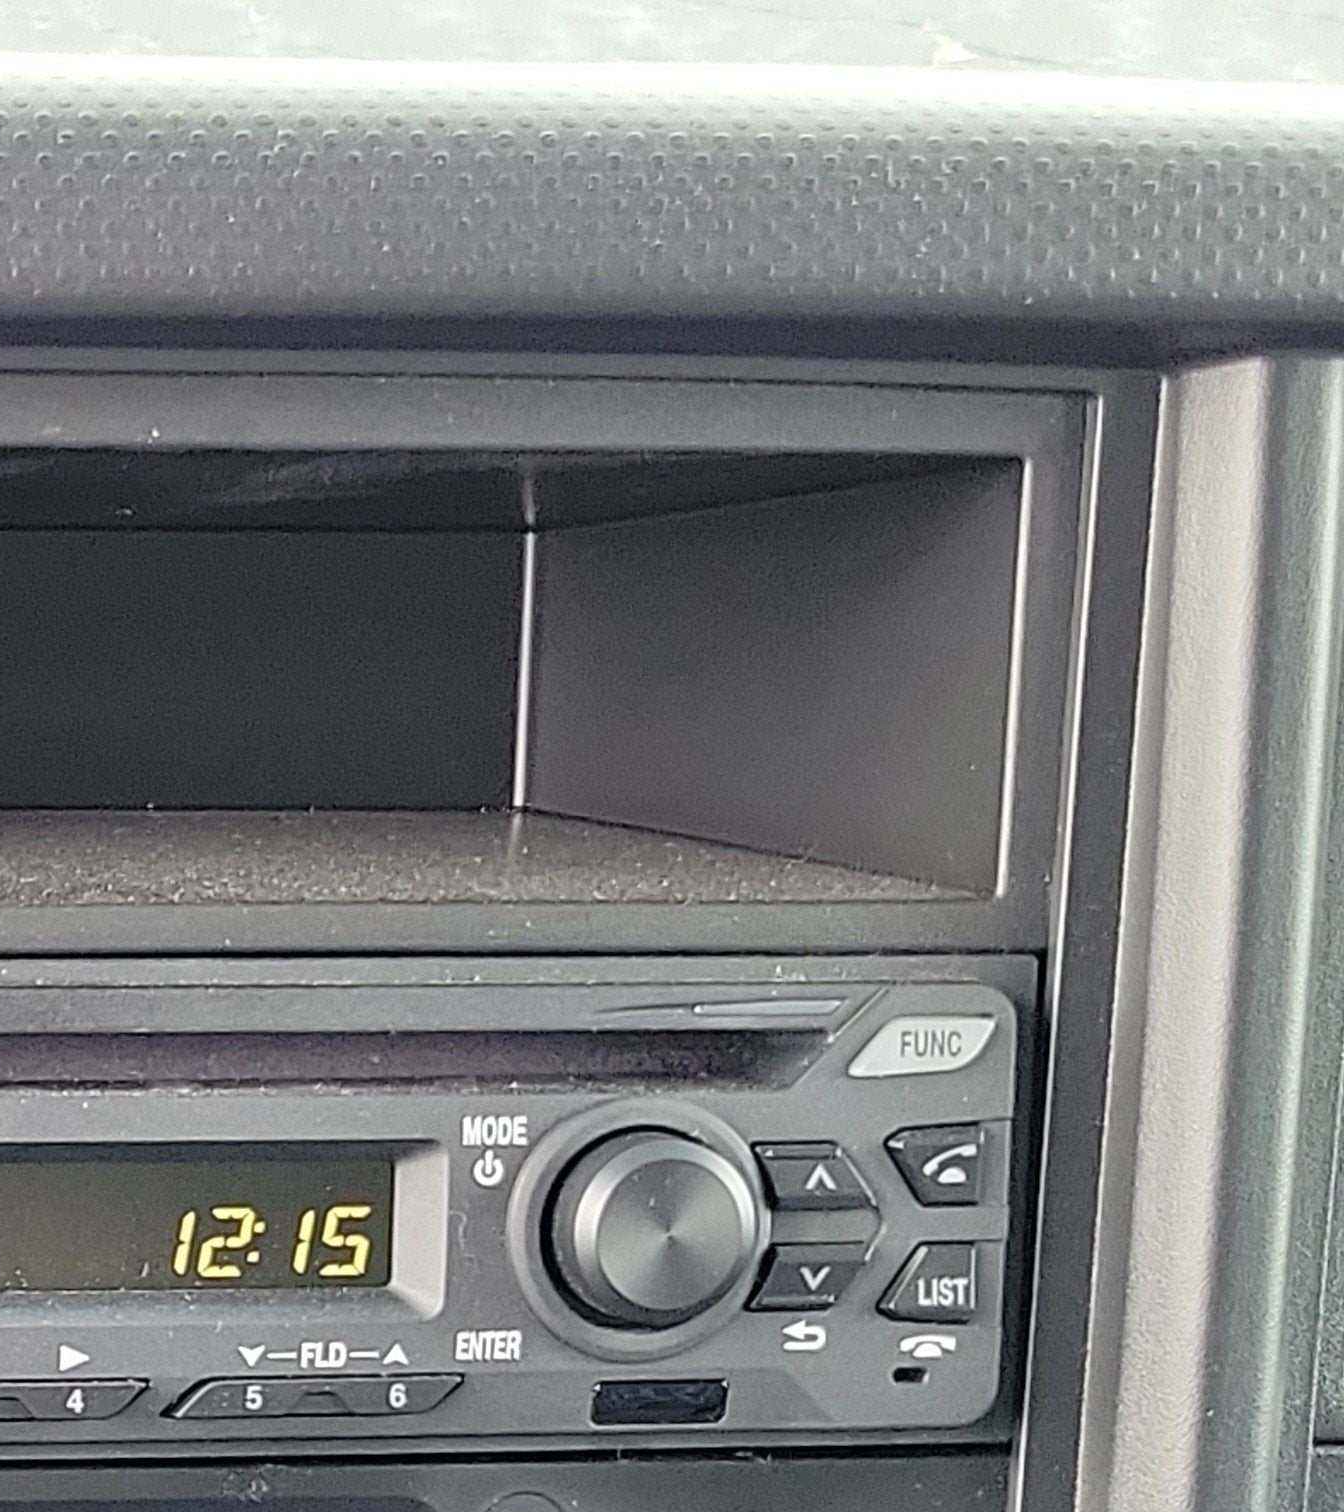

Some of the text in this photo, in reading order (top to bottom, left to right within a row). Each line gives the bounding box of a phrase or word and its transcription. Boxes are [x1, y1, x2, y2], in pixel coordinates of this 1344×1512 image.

[901, 1030, 963, 1058] FUNC
[461, 1115, 528, 1147] MODE
[173, 1205, 372, 1278] 12:15
[917, 1276, 969, 1308] LIST
[300, 1341, 348, 1370] FLD
[454, 1330, 523, 1361] ENTER
[65, 1388, 85, 1414] 4
[243, 1384, 263, 1410] 5
[388, 1383, 407, 1409] 6
